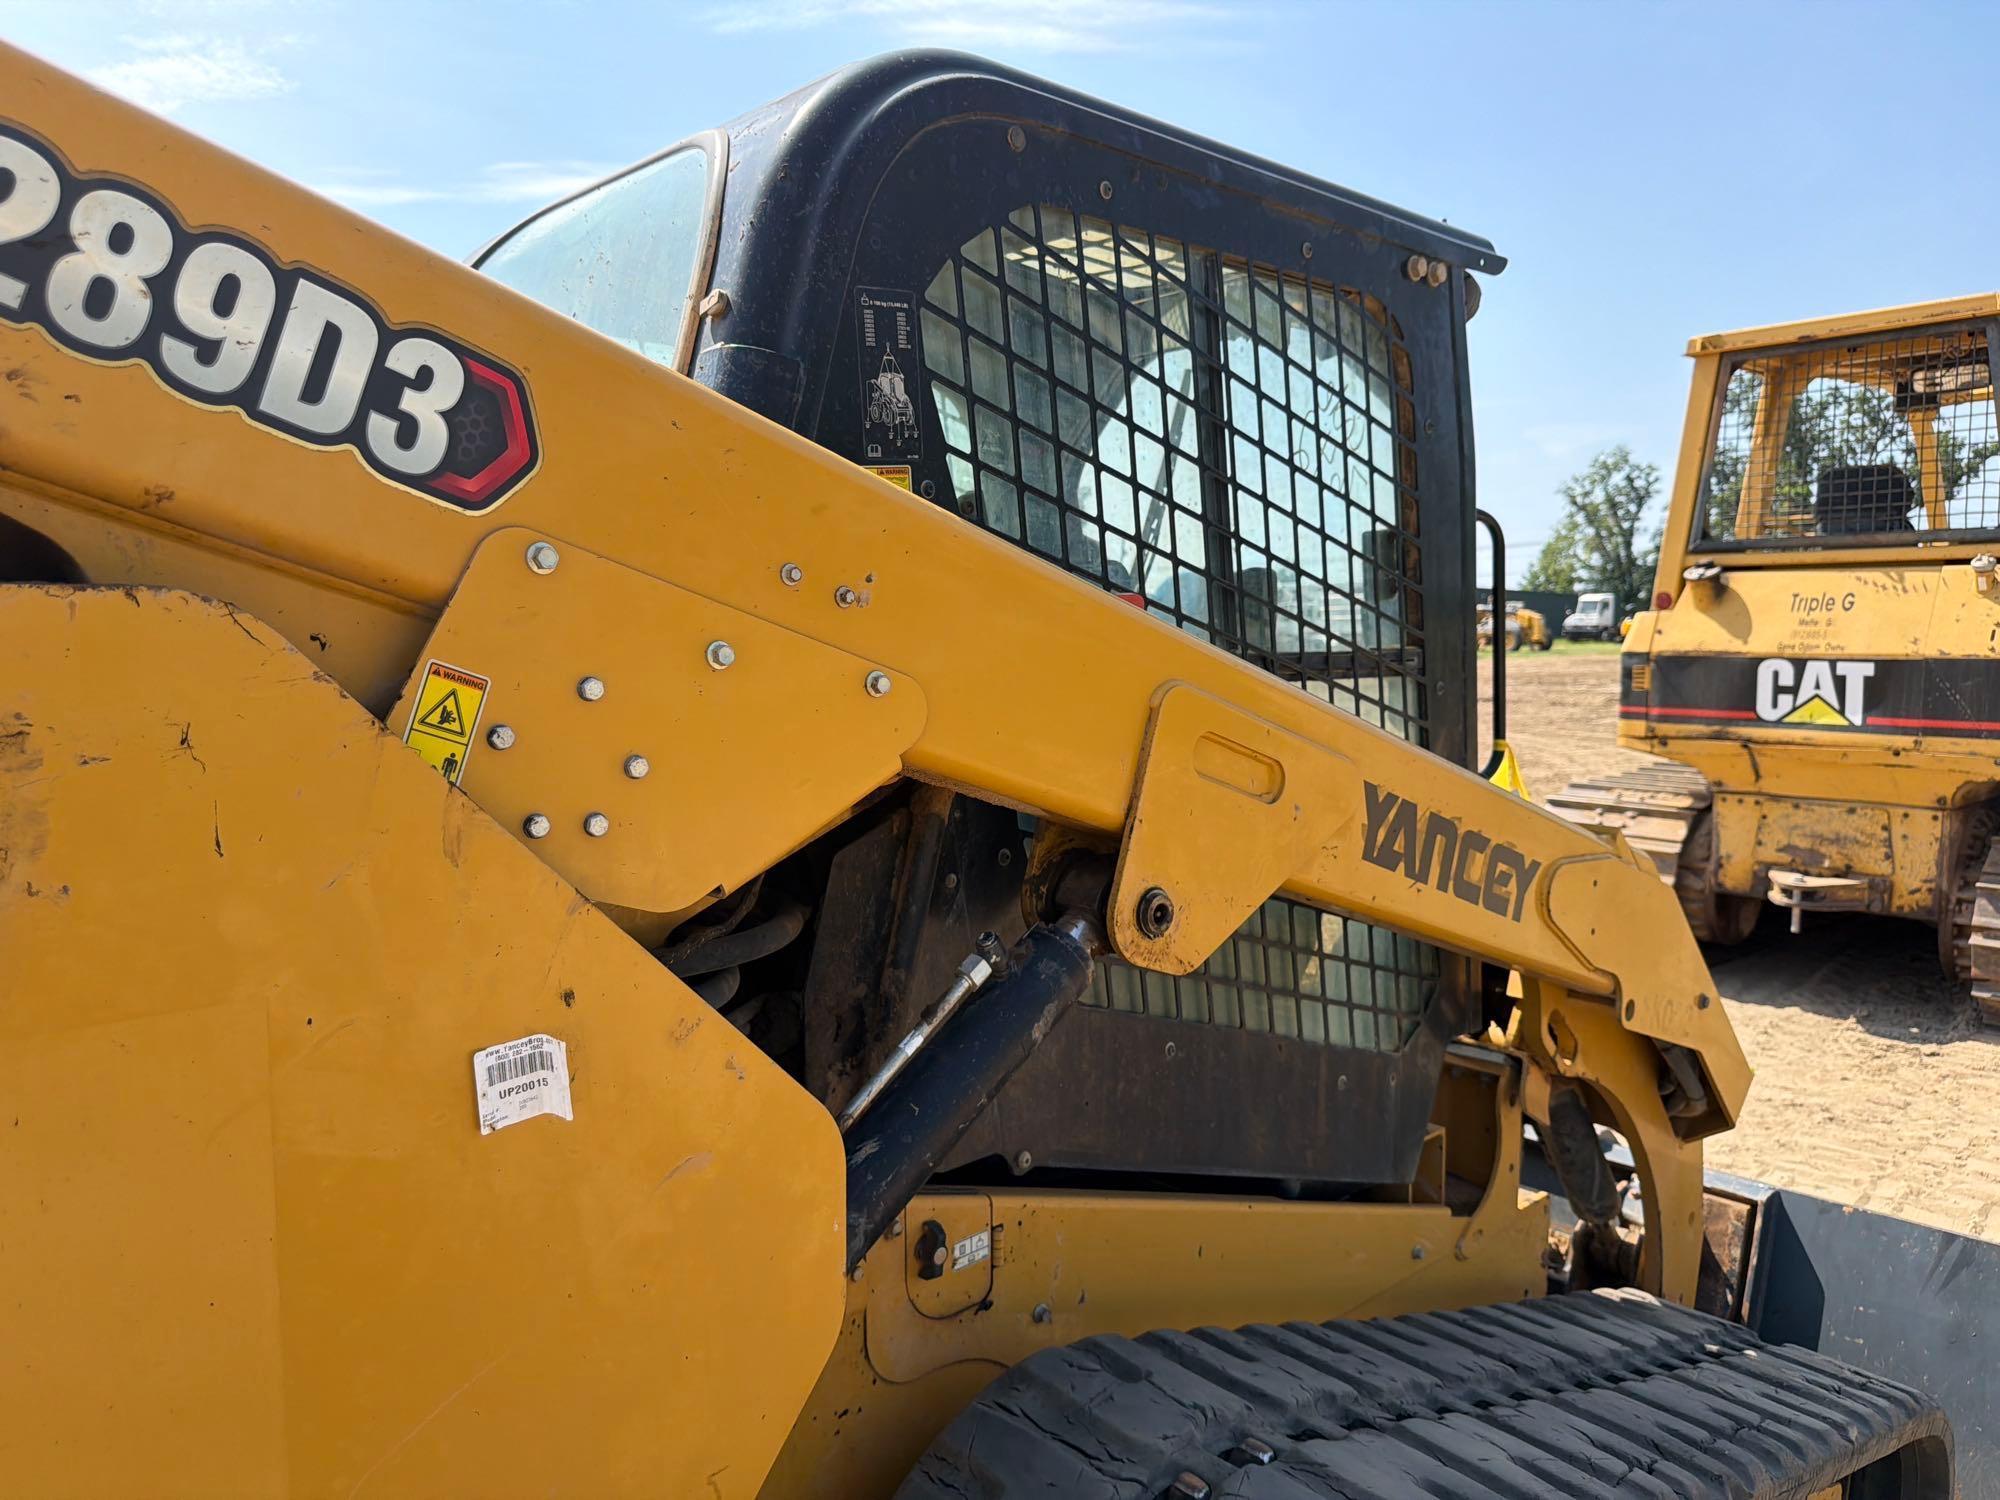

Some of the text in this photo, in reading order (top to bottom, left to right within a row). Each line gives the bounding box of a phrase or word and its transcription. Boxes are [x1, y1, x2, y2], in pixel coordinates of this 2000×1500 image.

[1791, 592, 1856, 616] Triple G
[443, 670, 485, 691] WARNING
[1755, 658, 1875, 726] CAT
[1361, 780, 1541, 922] YANCEY
[499, 1077, 549, 1100] UP20015
